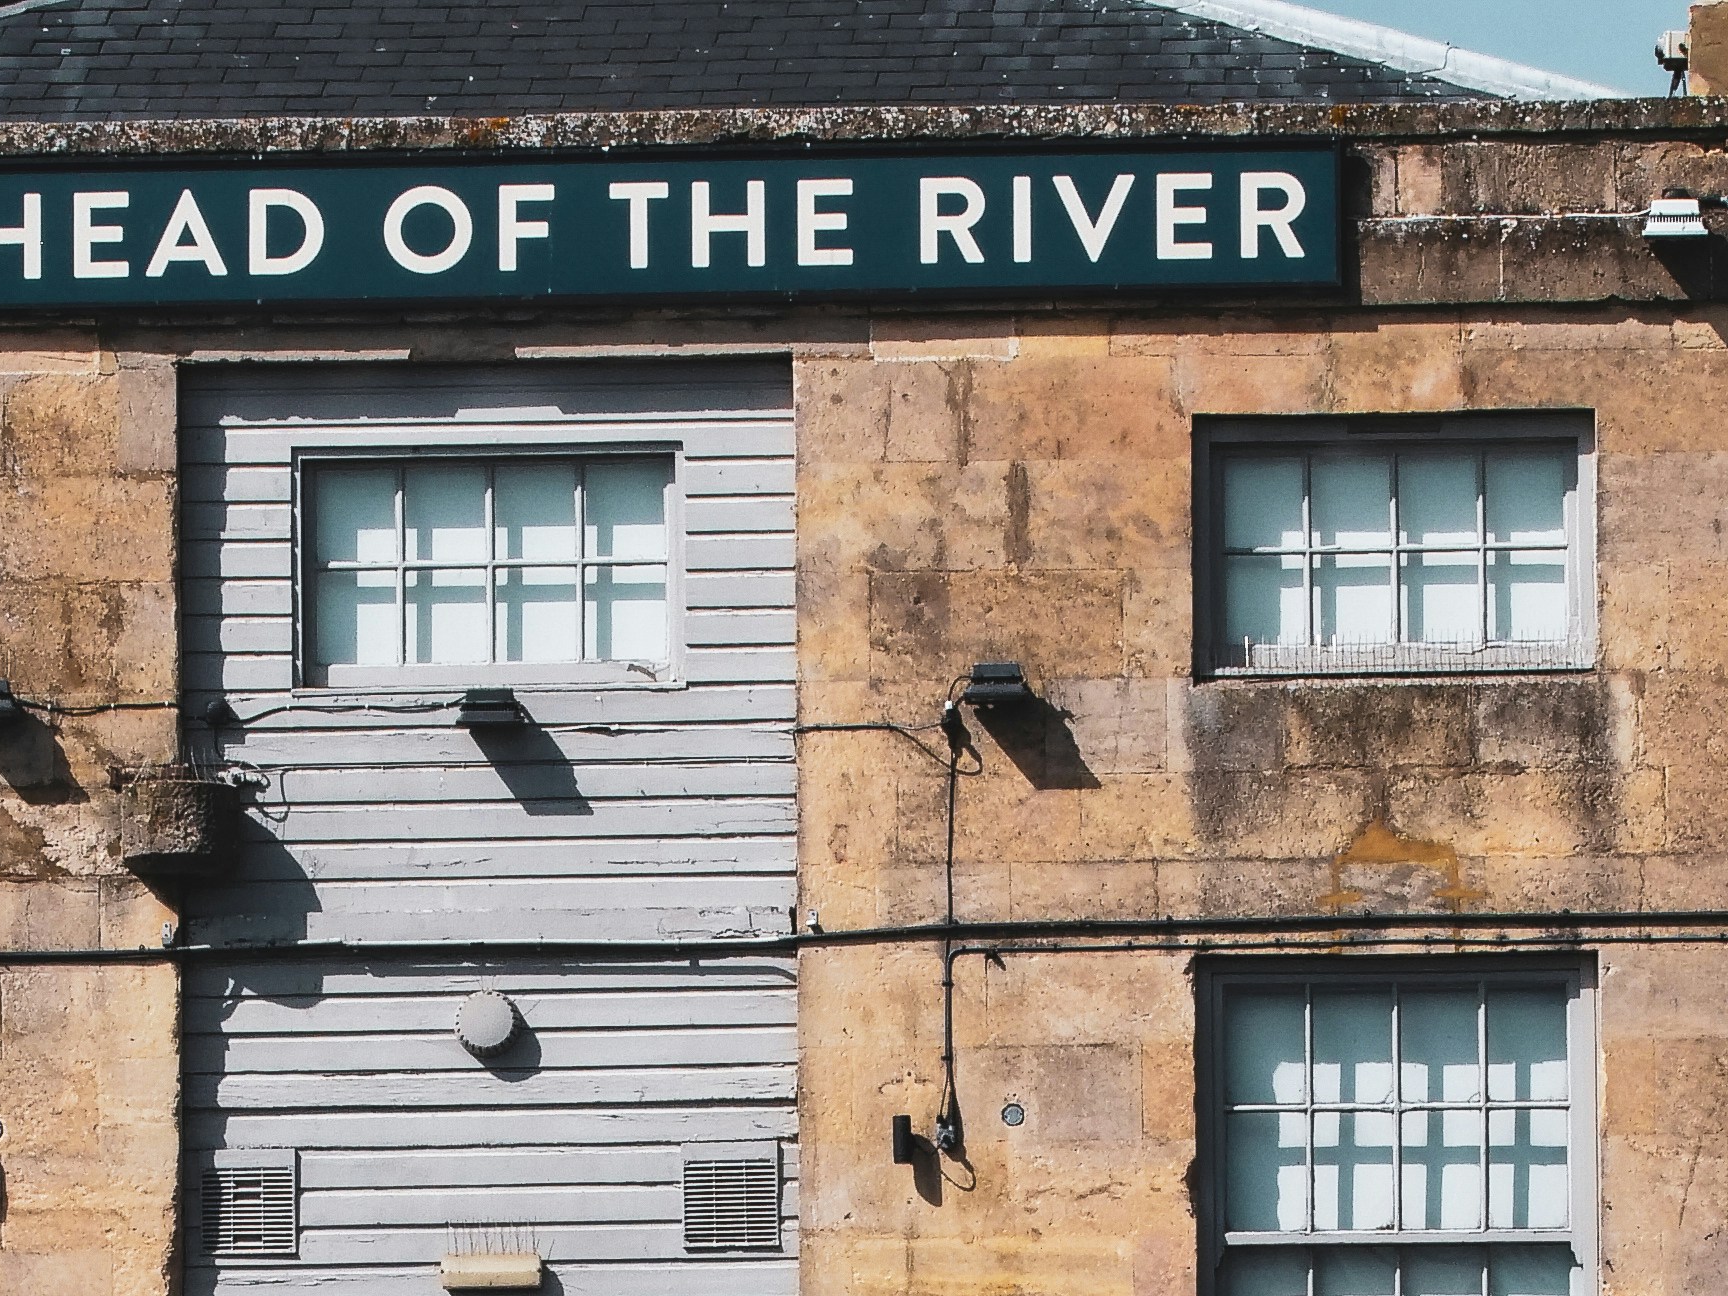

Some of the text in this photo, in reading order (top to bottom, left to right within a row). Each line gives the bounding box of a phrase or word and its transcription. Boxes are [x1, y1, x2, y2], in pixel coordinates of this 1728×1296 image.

[382, 182, 556, 276] OF
[607, 177, 855, 271] THE
[918, 171, 1307, 265] RIVER
